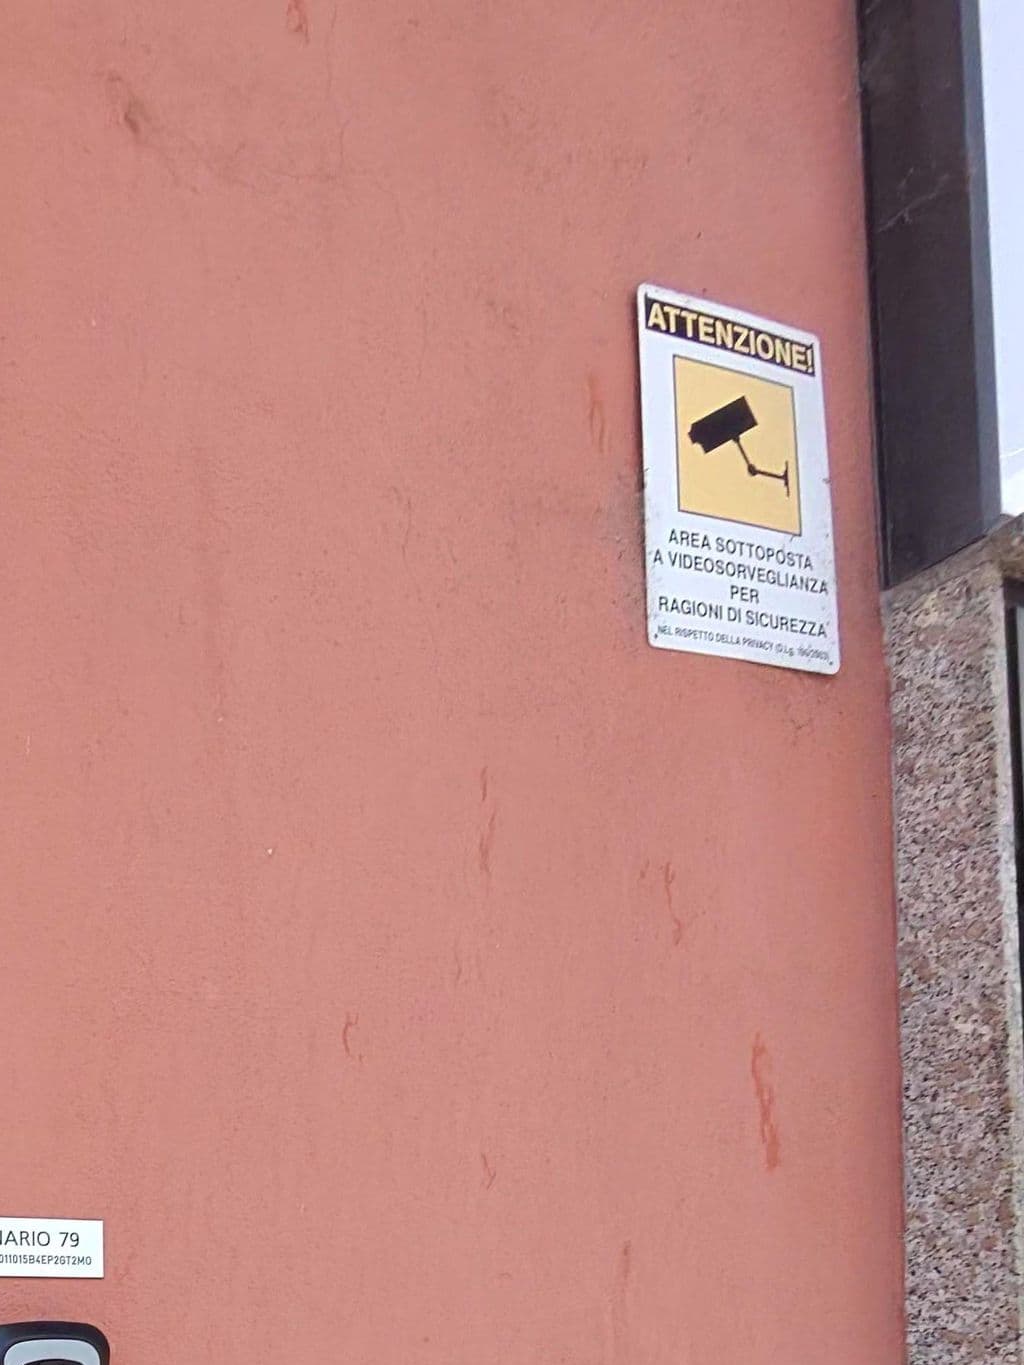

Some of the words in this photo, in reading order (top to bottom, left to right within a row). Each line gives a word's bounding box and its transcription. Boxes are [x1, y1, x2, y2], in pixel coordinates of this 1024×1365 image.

[647, 303, 813, 372] ATTENZIONE!
[668, 529, 711, 550] AREA
[715, 536, 813, 570] SOTTOPOSTA
[653, 549, 663, 565] A
[668, 551, 828, 595] VIDEOSORVEGLIANZA
[730, 585, 759, 603] PER
[658, 597, 723, 620] RAGIONI
[727, 607, 741, 623] DI
[745, 610, 828, 637] SICUREZZA
[59, 1232, 80, 1248] 79
